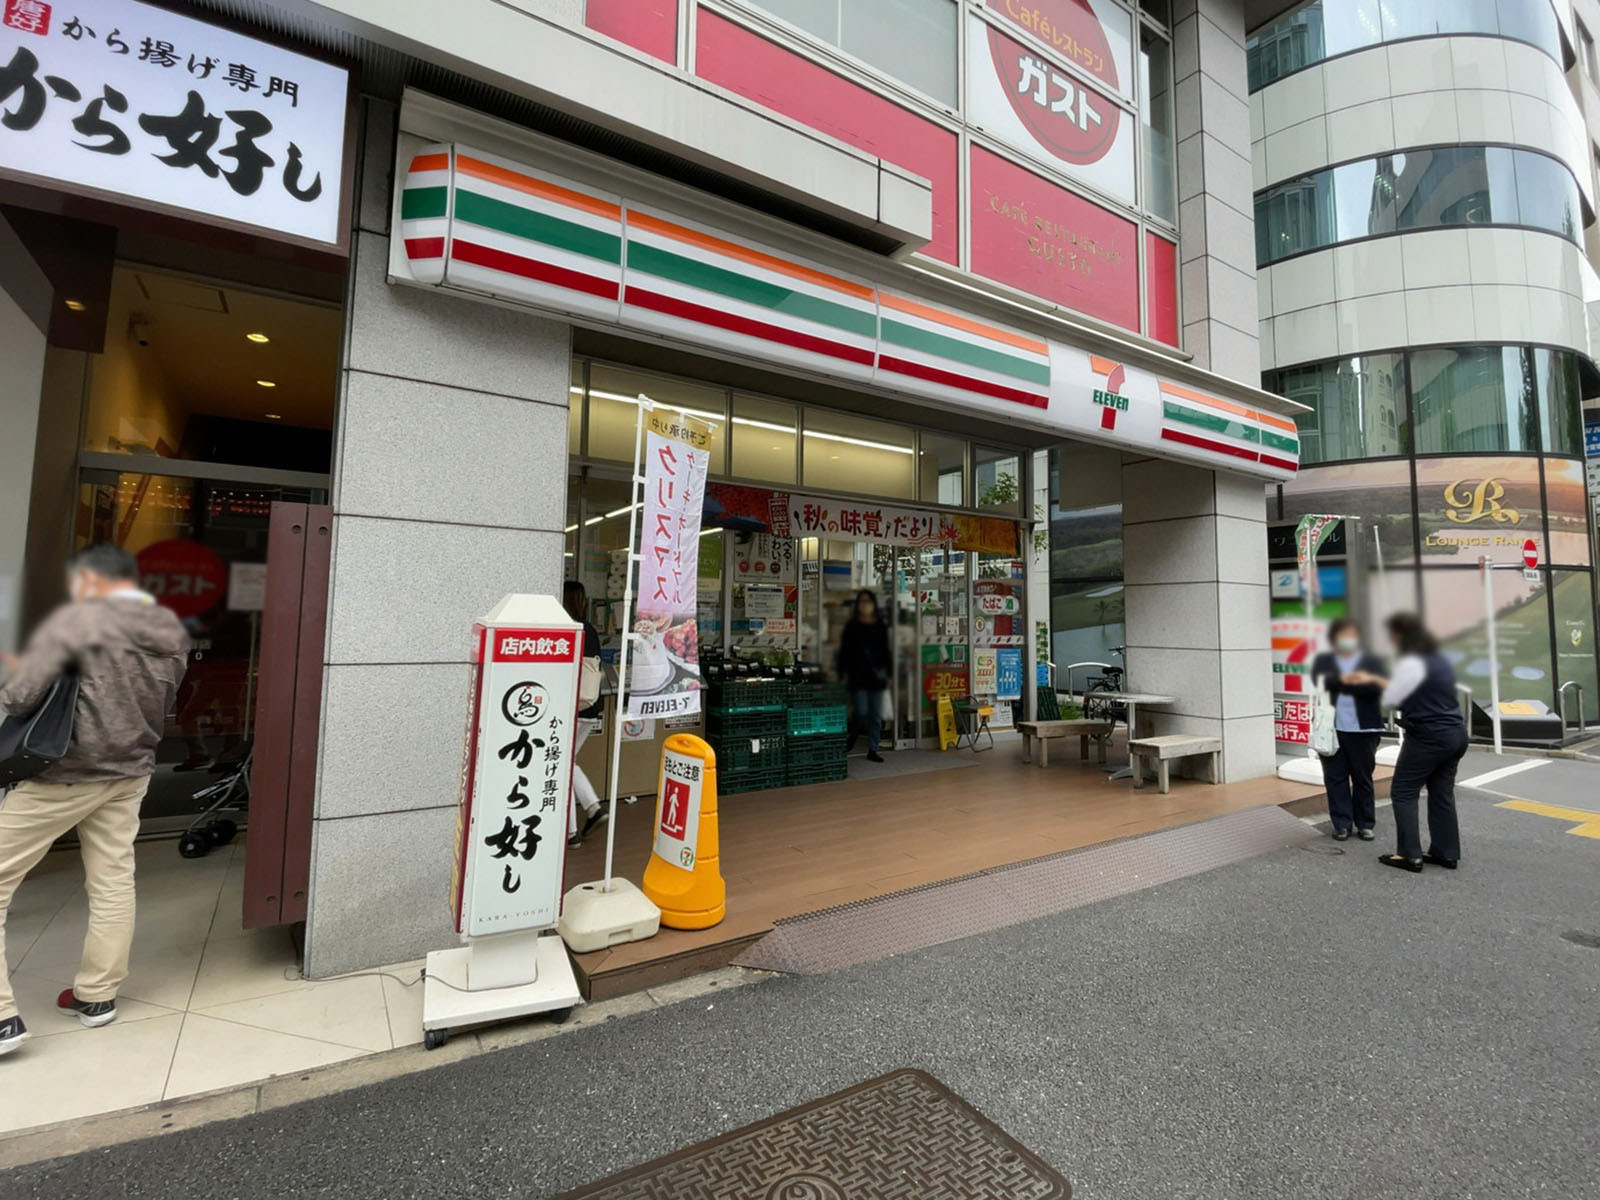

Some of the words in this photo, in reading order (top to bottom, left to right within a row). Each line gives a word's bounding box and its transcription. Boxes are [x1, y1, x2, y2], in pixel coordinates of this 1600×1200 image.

[62, 16, 299, 107] から揚げ専門
[1018, 55, 1101, 131] ガスト
[0, 46, 322, 202] から好し
[1093, 389, 1129, 411] ELEVEN
[803, 503, 933, 539] 秋の味覚だより
[1426, 535, 1490, 547] LOUNGE
[1495, 535, 1541, 547] RANE
[983, 597, 1002, 609] たばこ
[500, 637, 570, 656] 店内飲食
[1285, 702, 1313, 721] たば
[538, 715, 563, 813] から揚げ専門
[485, 728, 546, 894] から好し
[479, 907, 549, 923] KARA-YOSHI
